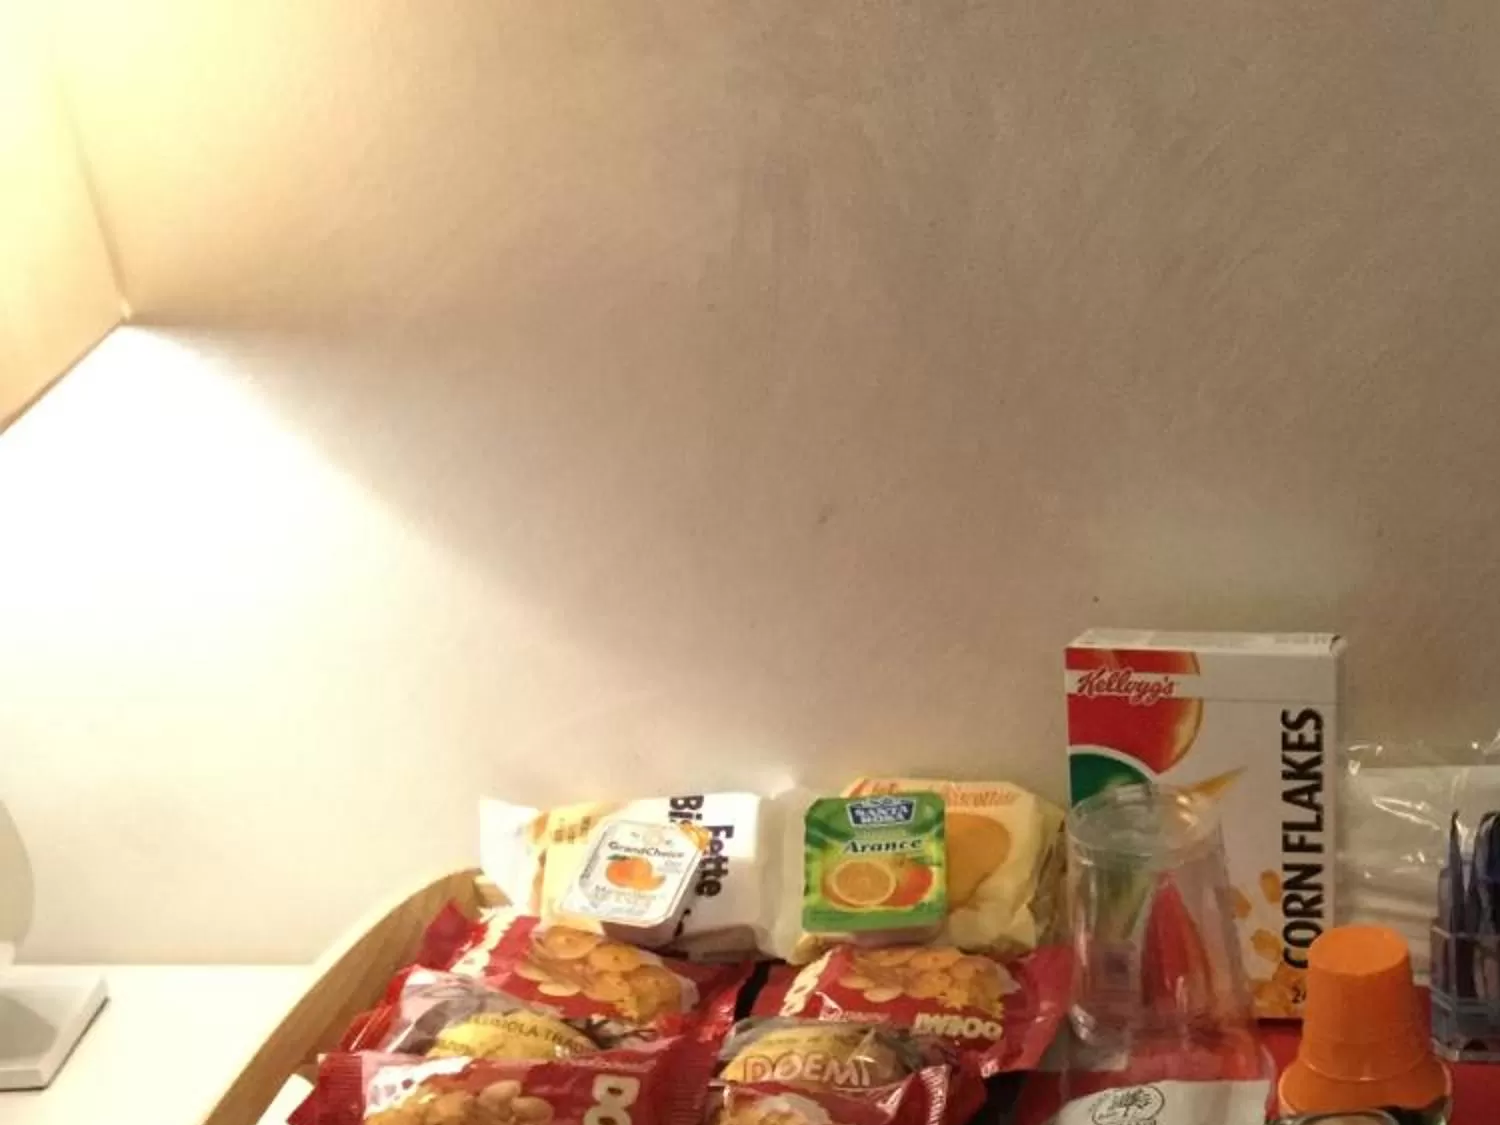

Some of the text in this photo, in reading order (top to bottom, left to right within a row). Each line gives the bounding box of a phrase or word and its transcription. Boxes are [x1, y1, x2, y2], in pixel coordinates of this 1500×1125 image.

[1078, 668, 1175, 703] Kellogg's
[695, 825, 734, 897] Fette
[843, 837, 923, 854] Arance
[1281, 707, 1325, 969] CORN FLAKES
